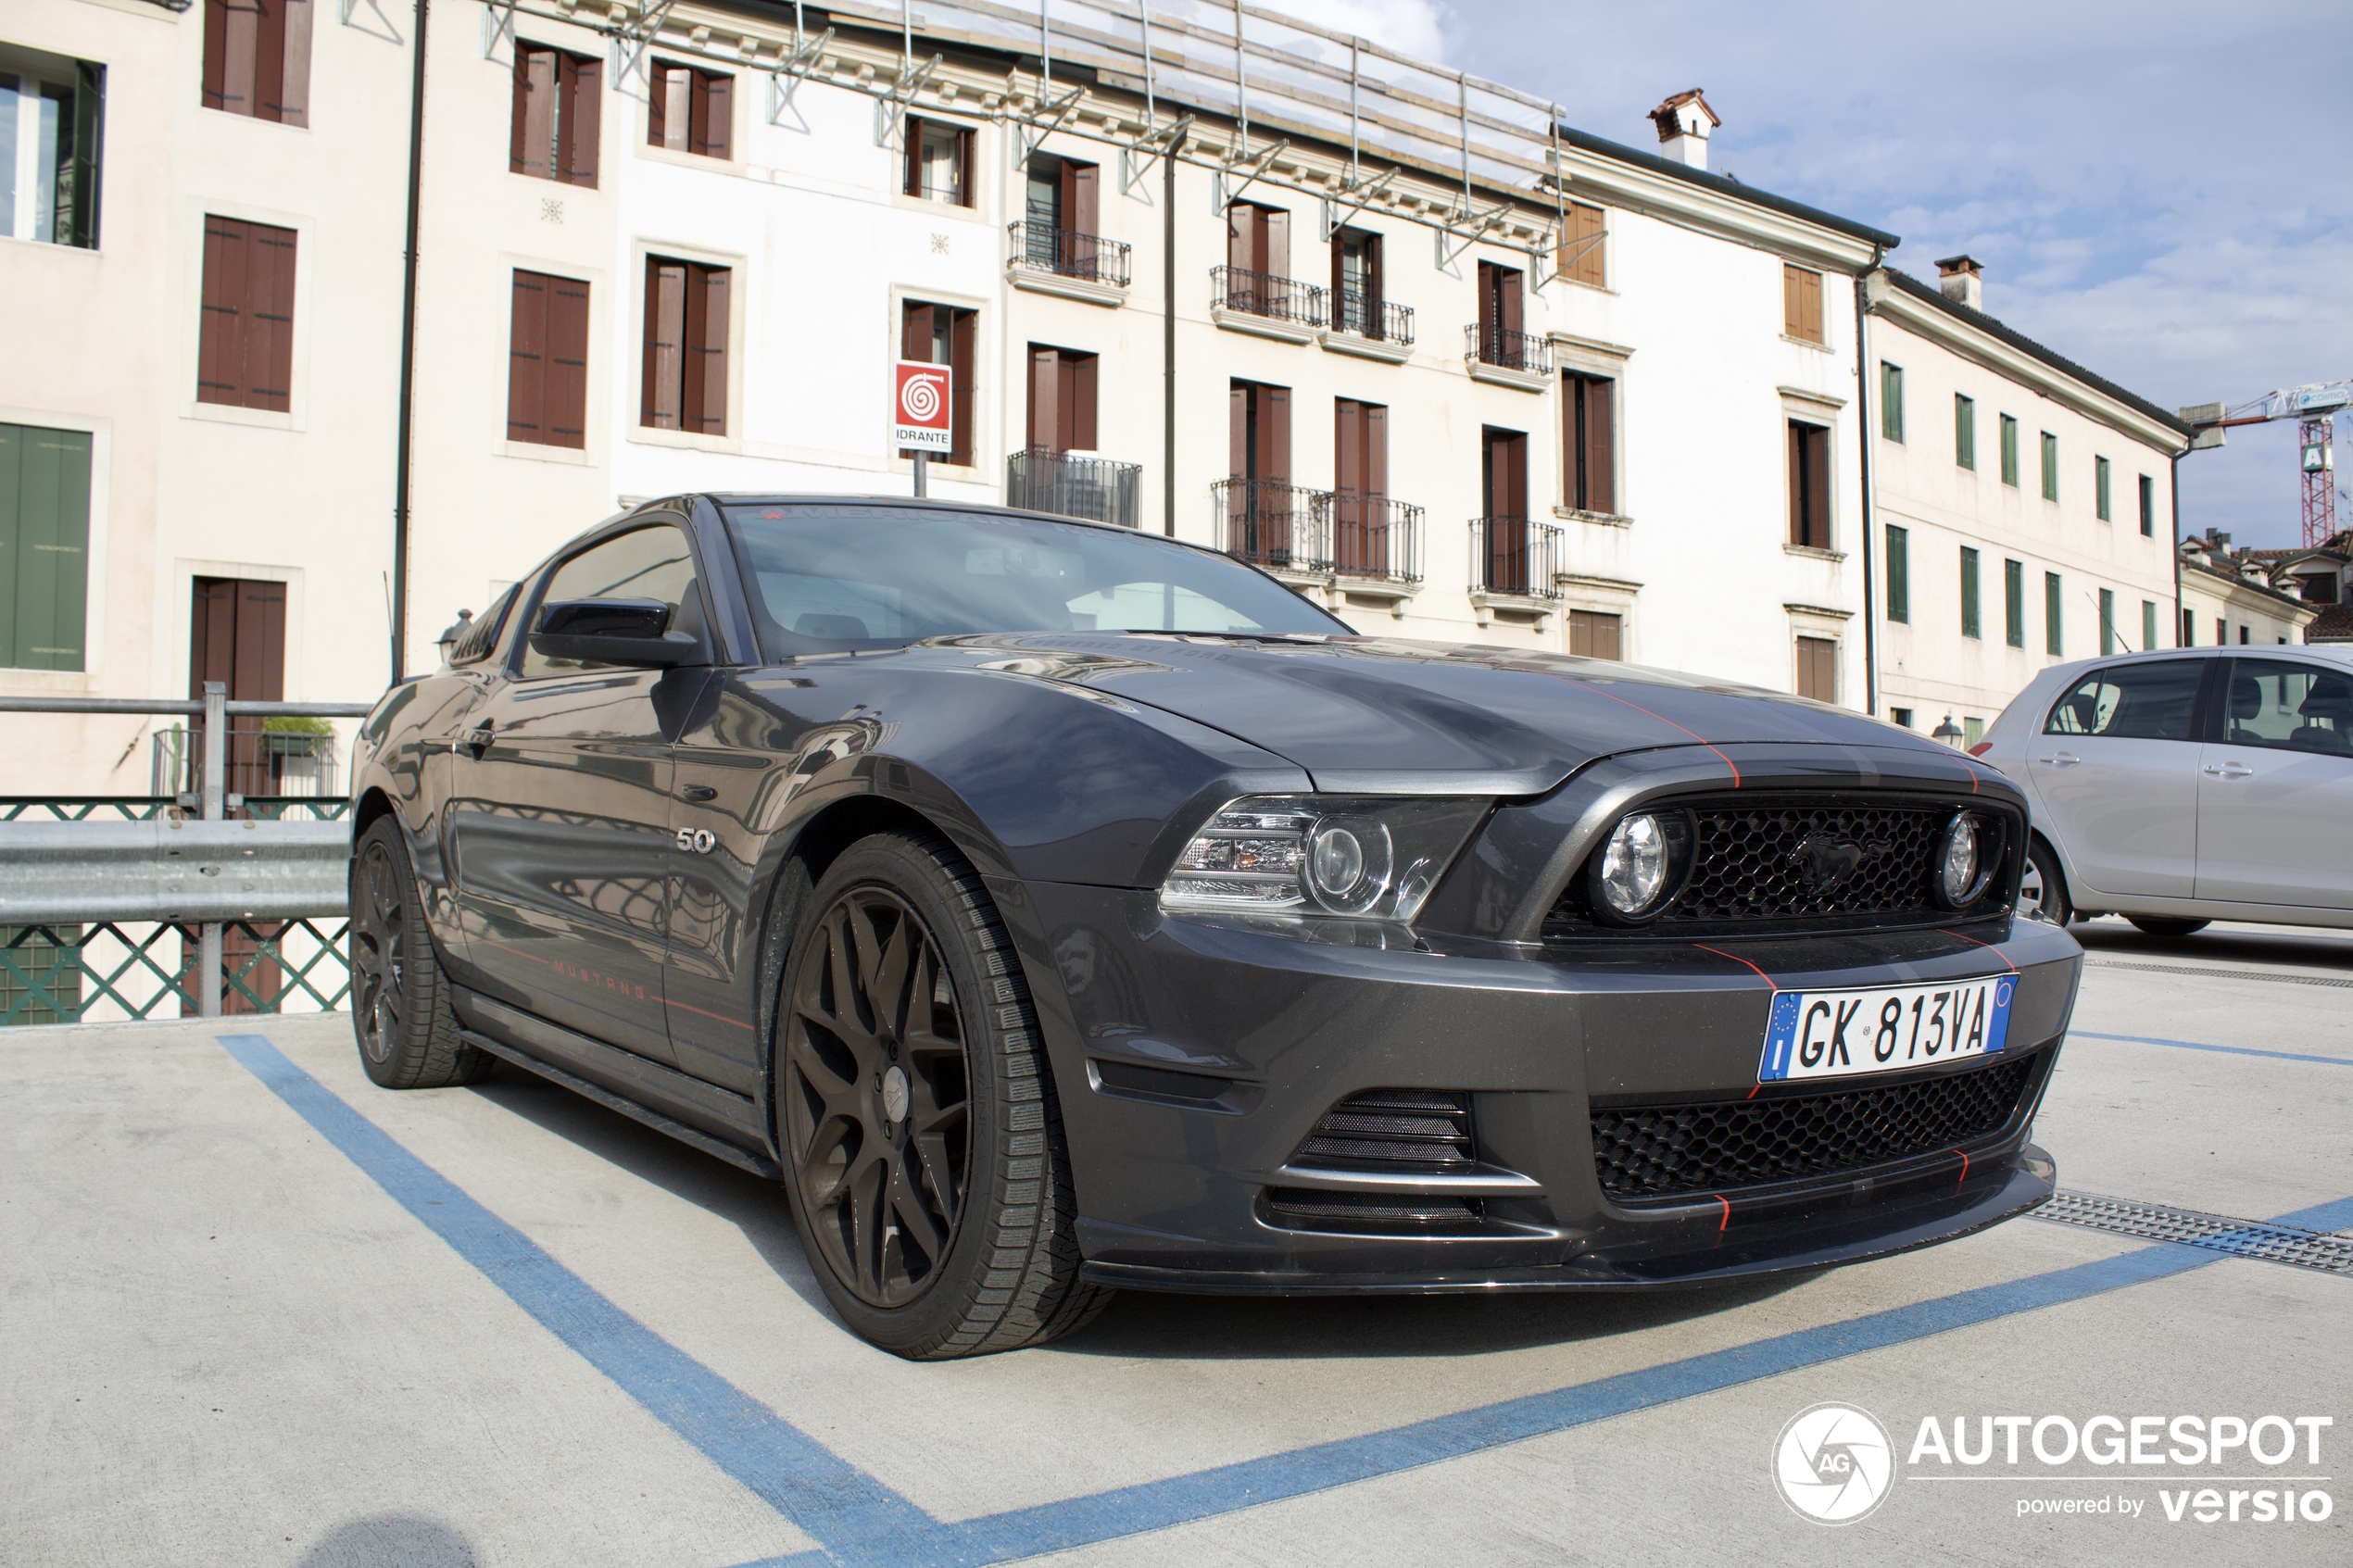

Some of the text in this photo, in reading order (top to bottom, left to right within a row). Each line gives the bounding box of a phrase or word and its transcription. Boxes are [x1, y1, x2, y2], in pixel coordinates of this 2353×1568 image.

[896, 429, 949, 444] IDRANTE
[2303, 447, 2322, 467] A
[554, 960, 645, 1000] MUSTANG
[1799, 985, 1986, 1068] GK 813VA
